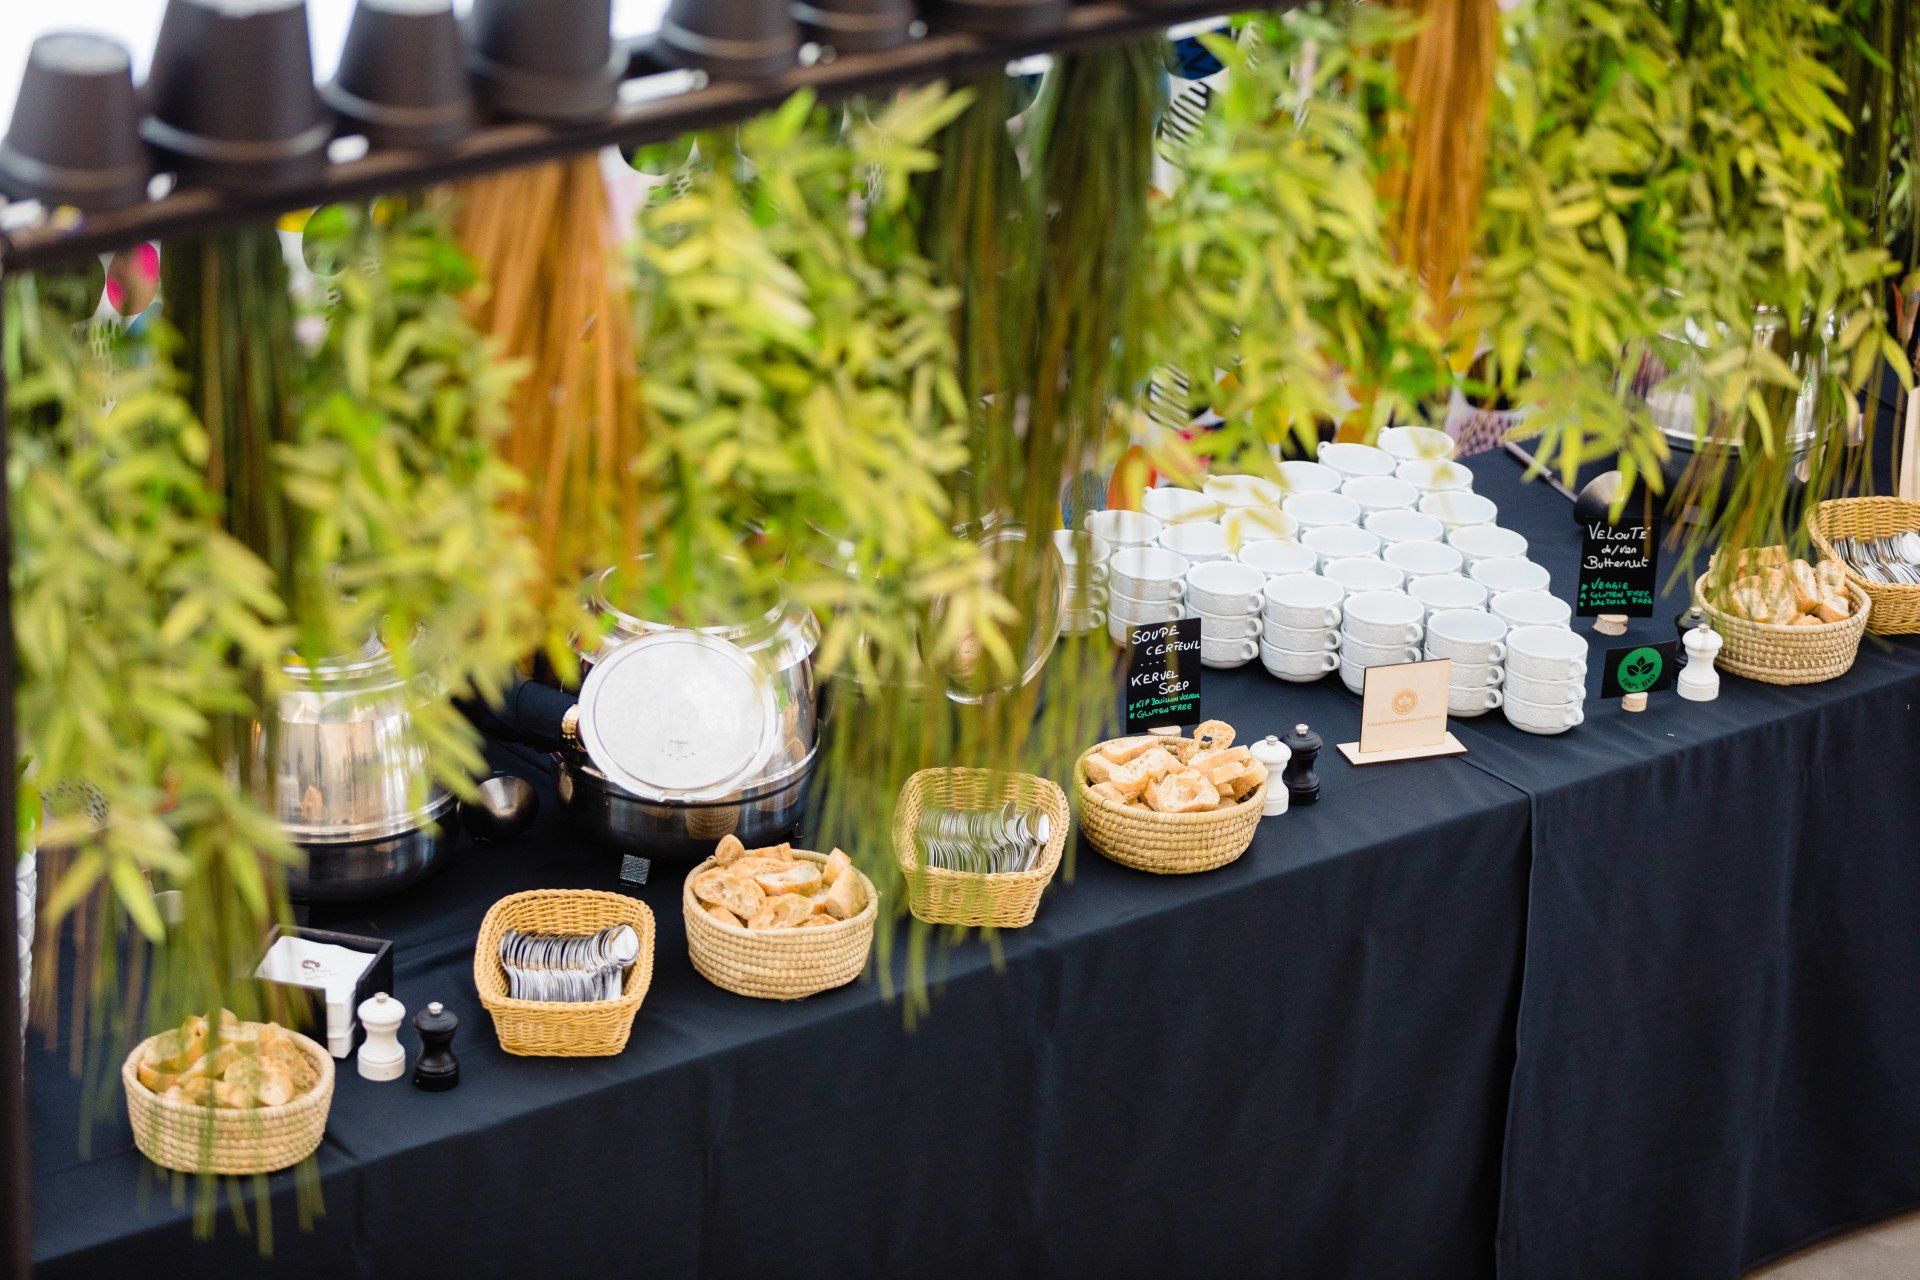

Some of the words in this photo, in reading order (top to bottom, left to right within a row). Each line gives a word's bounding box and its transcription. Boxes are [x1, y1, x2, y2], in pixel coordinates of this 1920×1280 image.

[1583, 555, 1649, 569] Butternut
[1131, 625, 1180, 645] SOUPE
[1131, 670, 1179, 687] KERVEL
[1158, 681, 1190, 695] SOEP
[1136, 706, 1169, 719] GLUTEN
[1170, 703, 1192, 712] FREE
